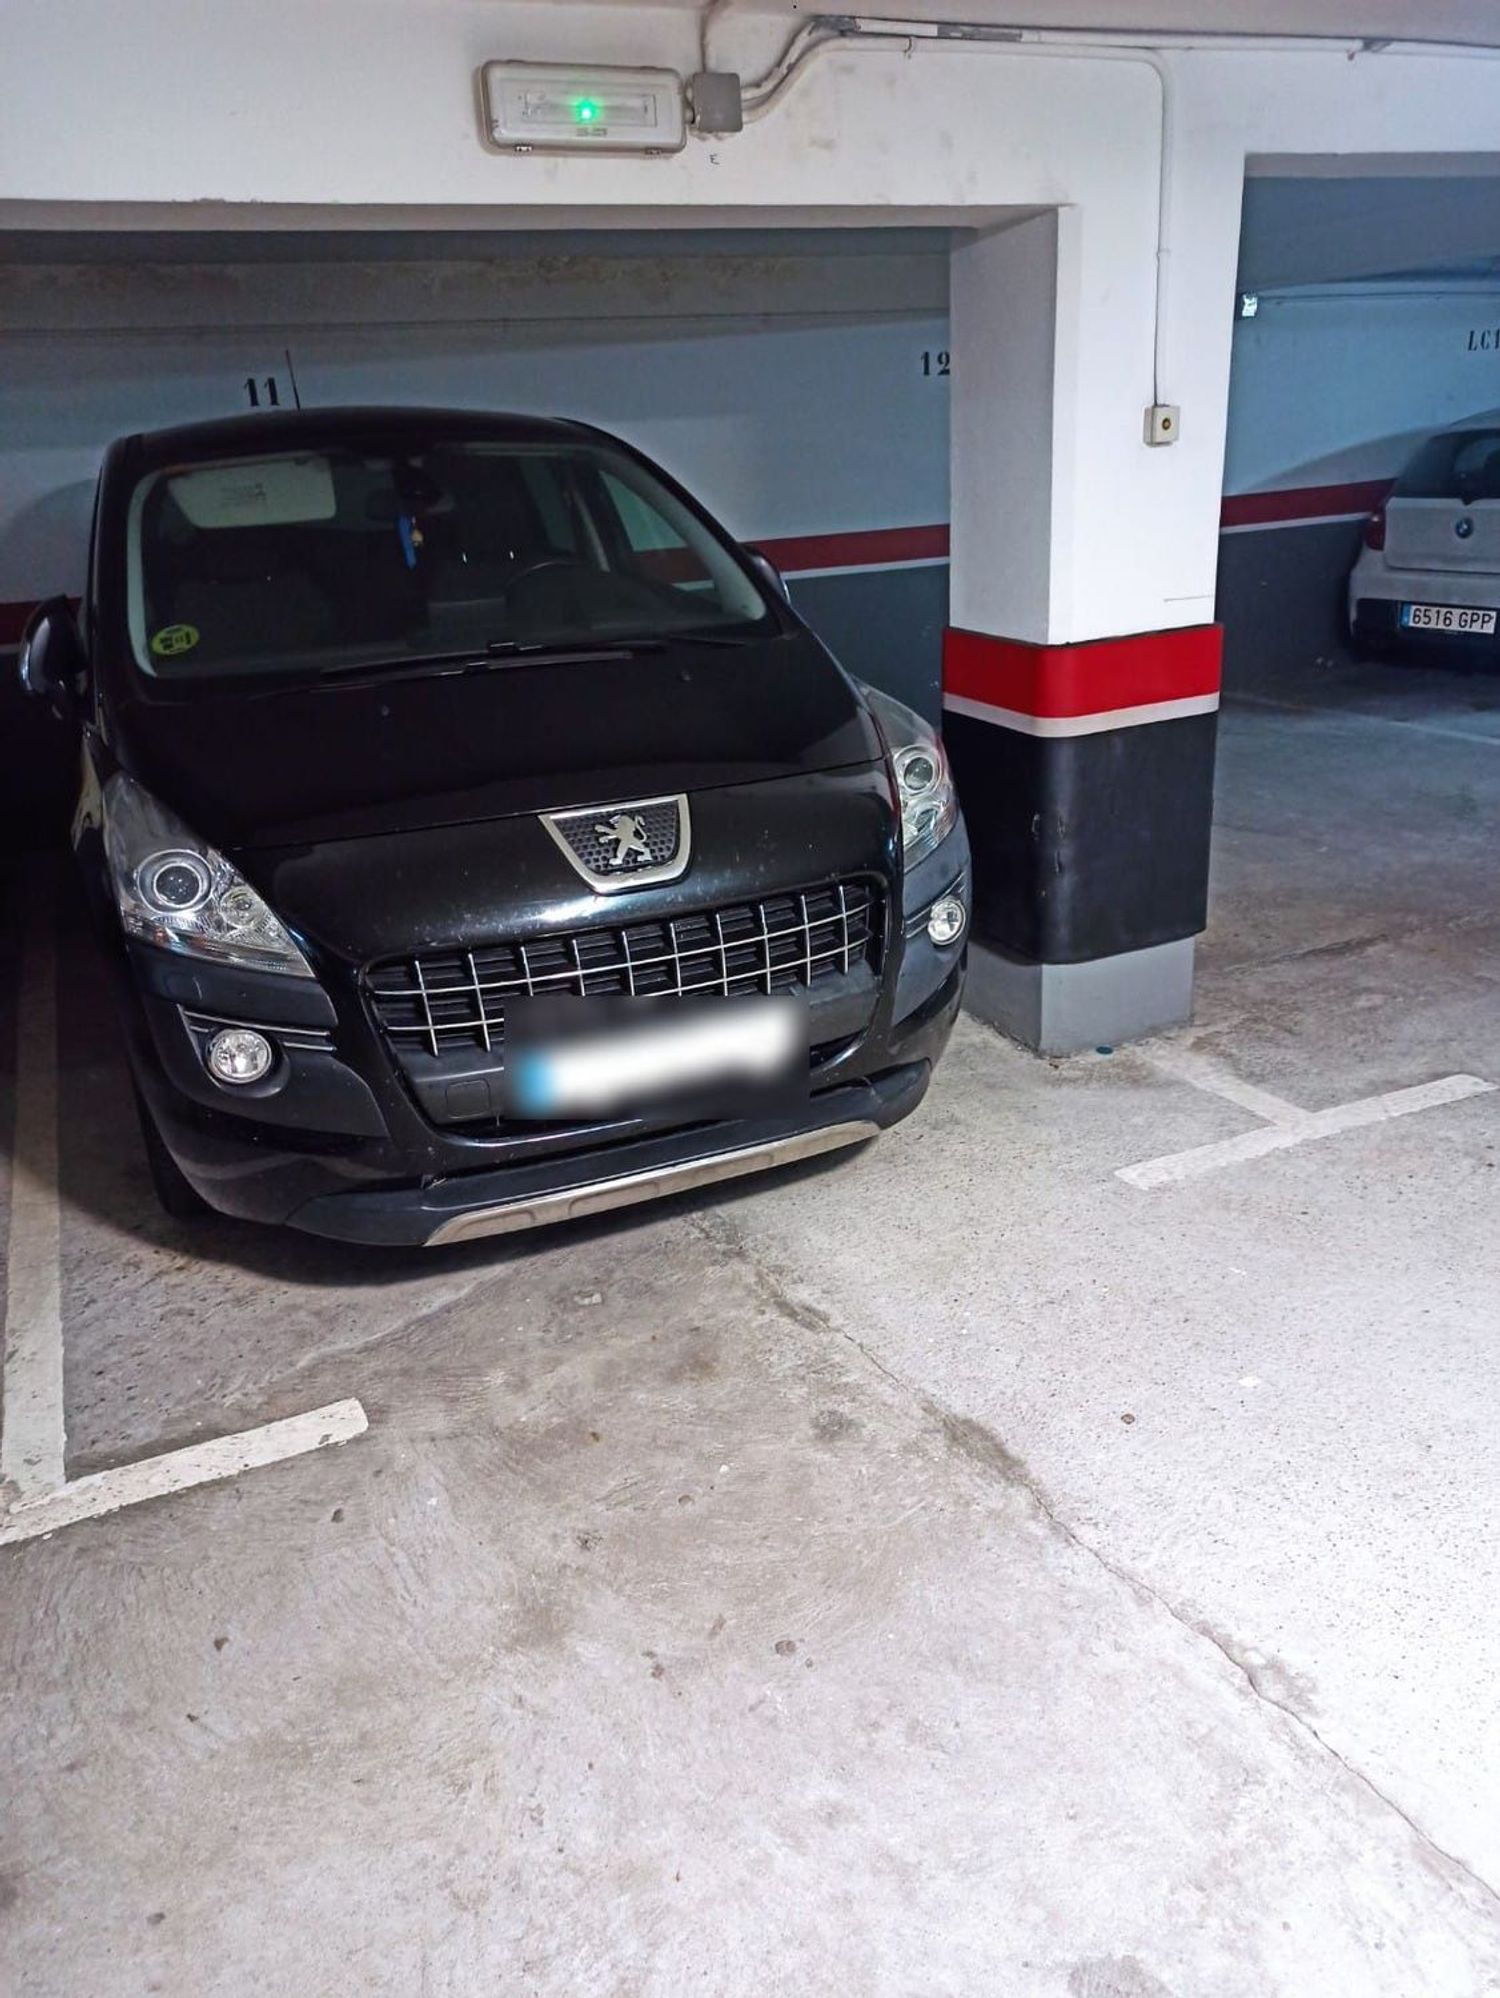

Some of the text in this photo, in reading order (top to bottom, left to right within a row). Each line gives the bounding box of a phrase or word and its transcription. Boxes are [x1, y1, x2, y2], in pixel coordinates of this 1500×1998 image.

[920, 351, 950, 376] 12
[243, 377, 280, 407] 11
[1412, 607, 1492, 630] 6516 GPP
